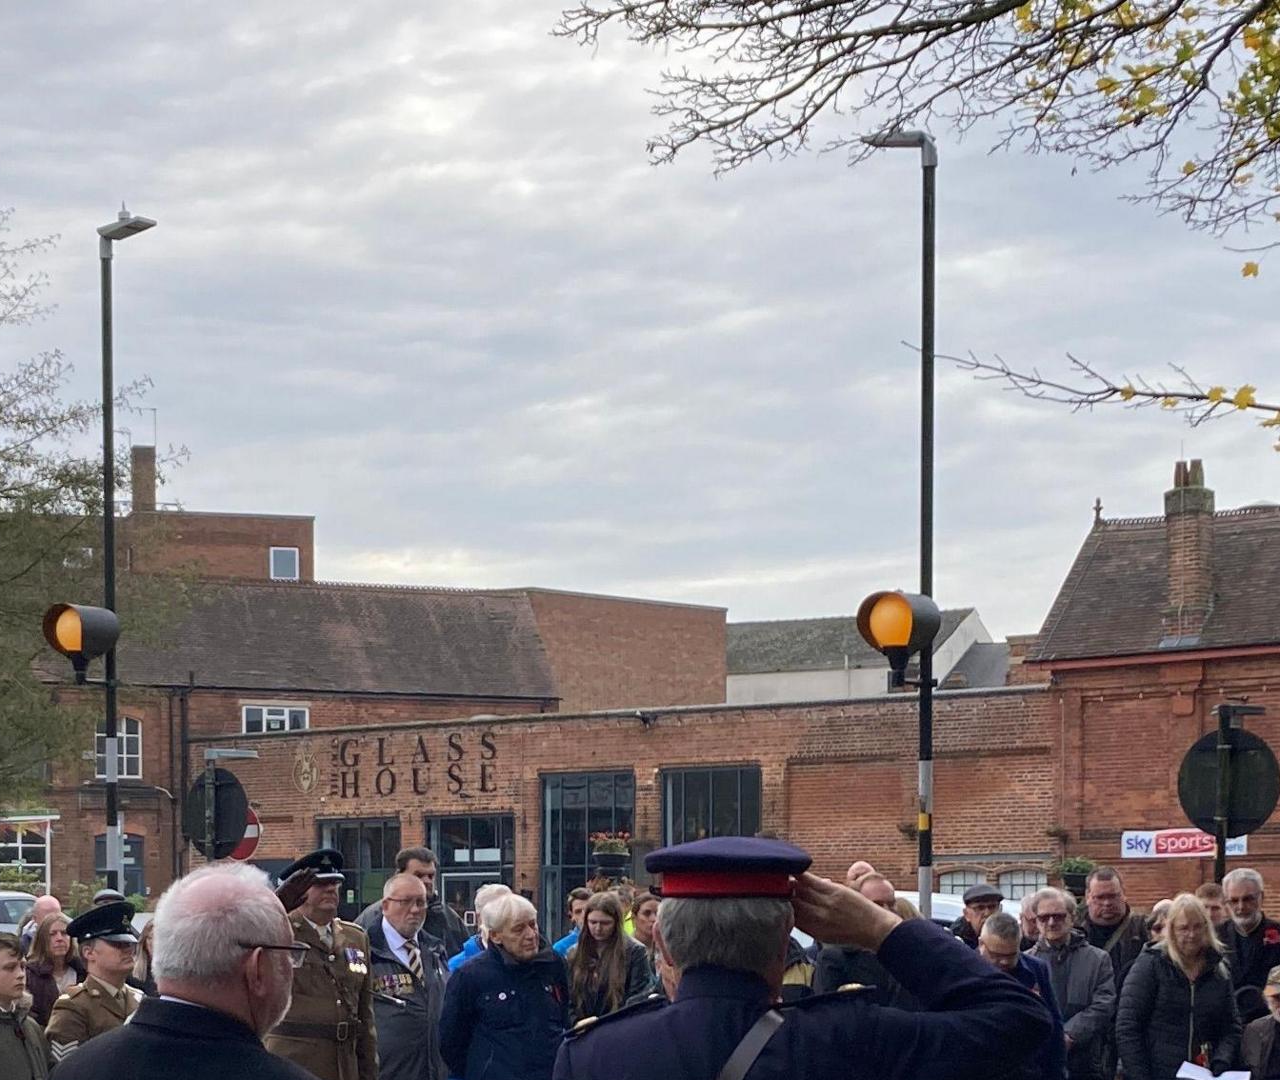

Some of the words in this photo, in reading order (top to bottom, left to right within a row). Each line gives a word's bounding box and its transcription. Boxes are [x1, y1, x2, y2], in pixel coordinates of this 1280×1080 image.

[340, 732, 497, 767] GLASS
[340, 764, 497, 798] HOUSE
[1126, 835, 1152, 853] sky
[1157, 834, 1212, 852] sports
